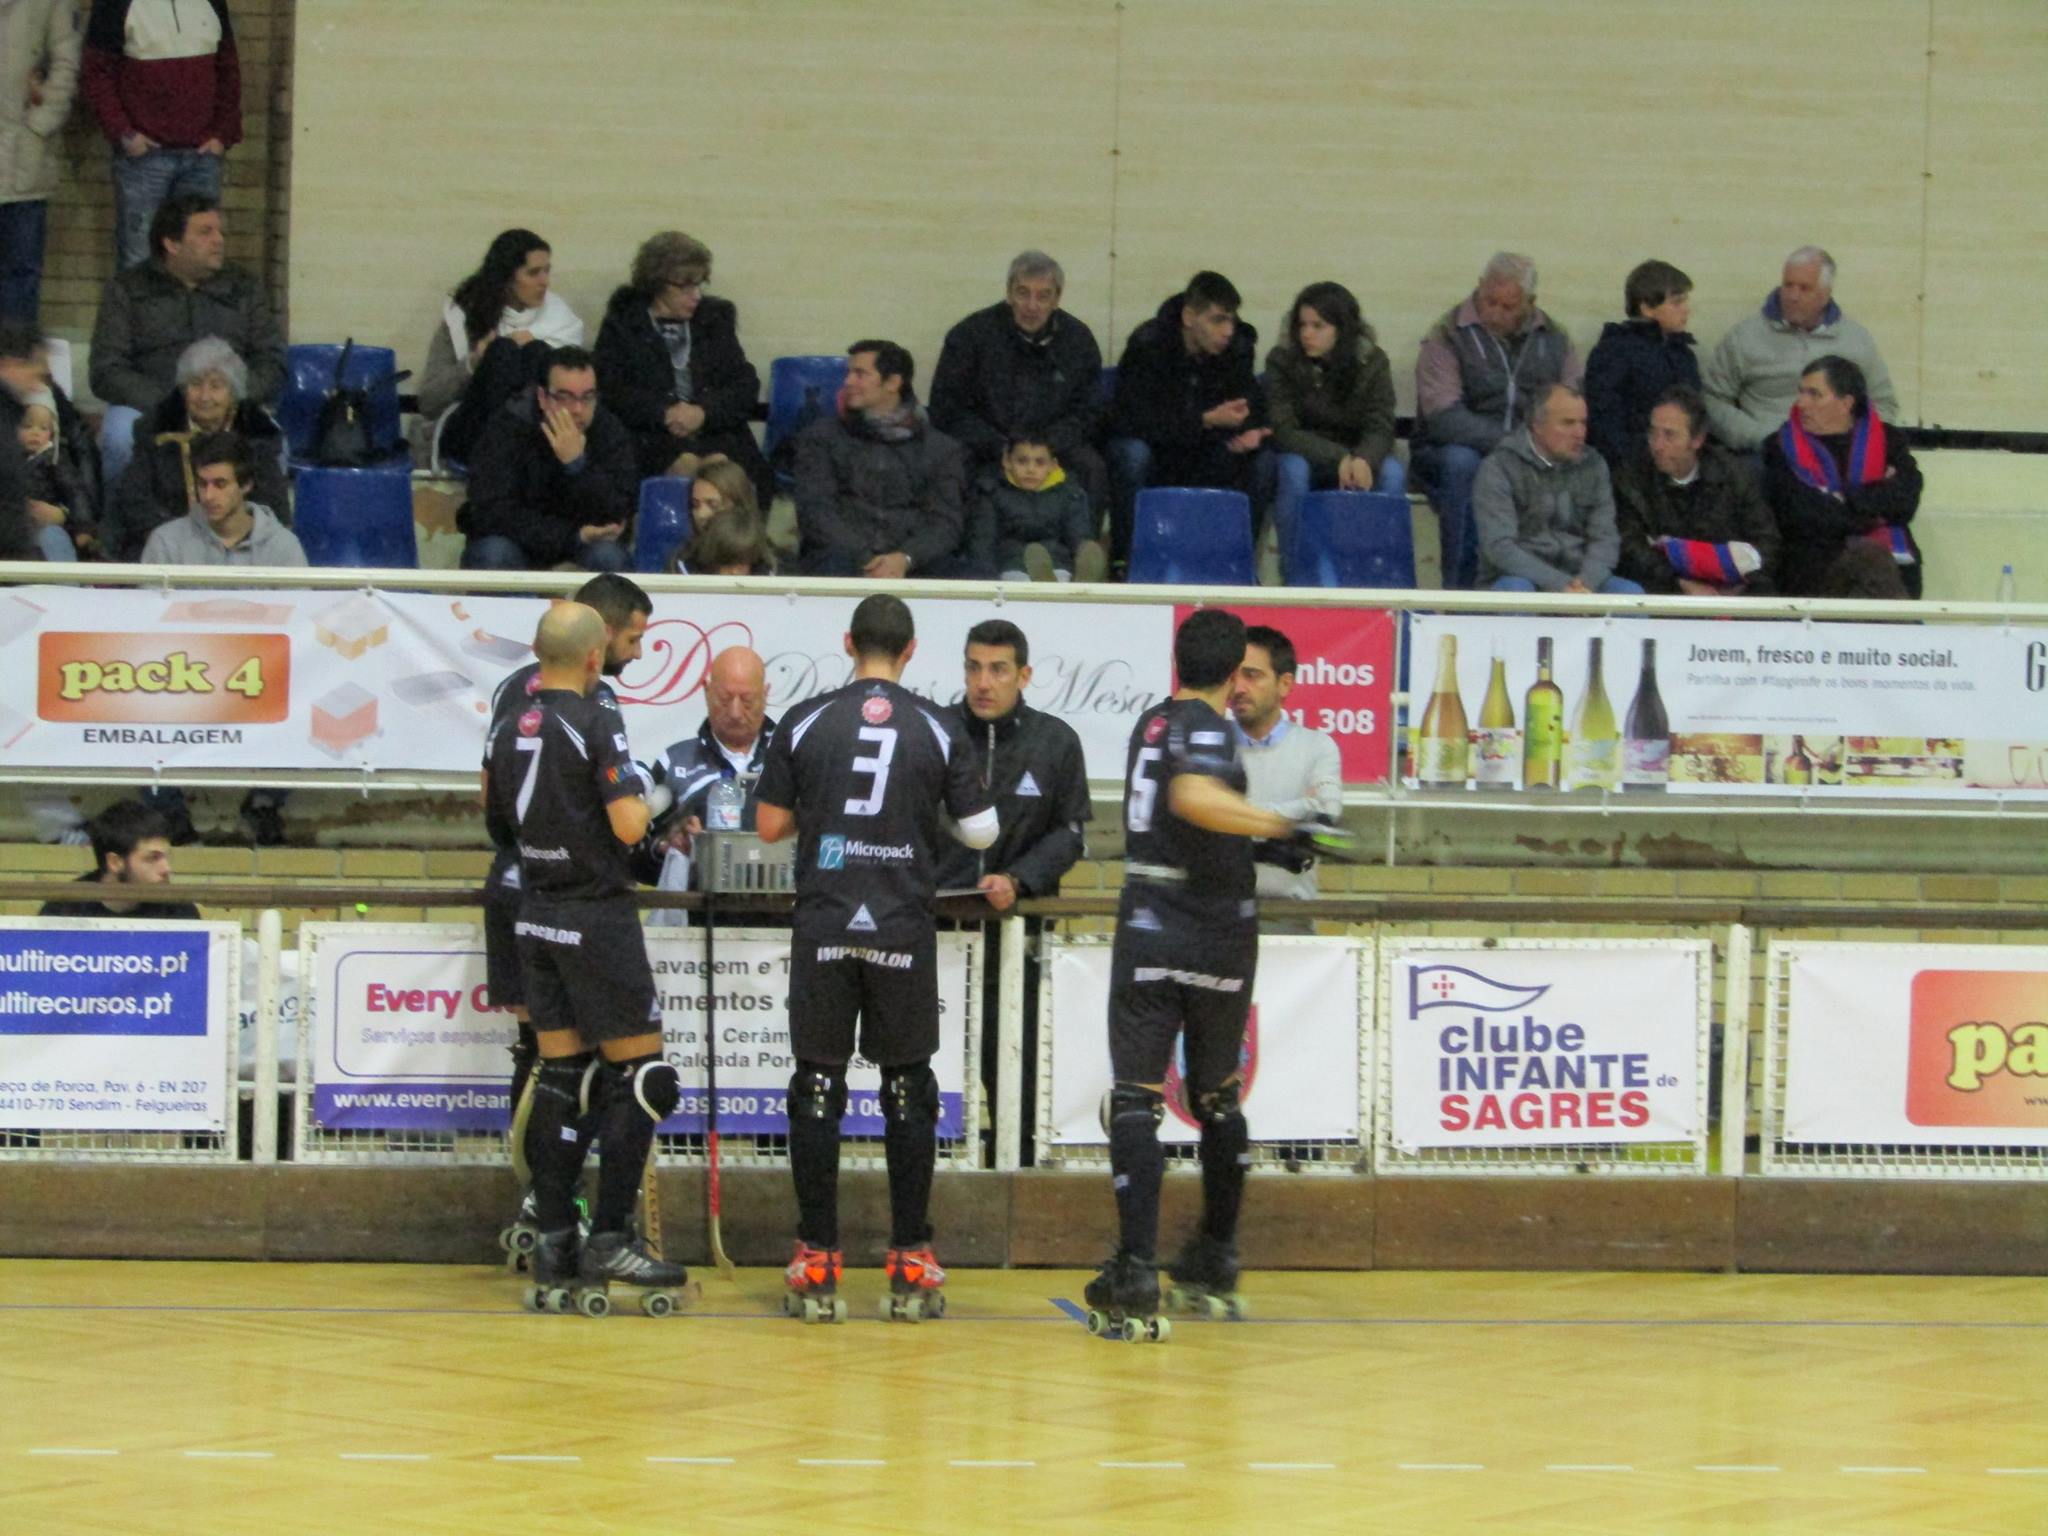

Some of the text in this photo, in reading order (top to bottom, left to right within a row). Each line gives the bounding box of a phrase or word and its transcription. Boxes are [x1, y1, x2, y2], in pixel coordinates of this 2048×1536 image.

[1688, 644, 1958, 668] Jovem, fresco e muito social.
[61, 651, 264, 700] pack 4
[1295, 657, 1375, 686] nhos
[84, 729, 243, 745] EMBALAGEM
[516, 737, 543, 825] 7
[844, 727, 897, 815] 3
[845, 840, 914, 860] Micropack
[651, 959, 749, 979] avagem
[758, 961, 771, 975] e
[366, 983, 461, 1019] Every
[660, 991, 773, 1011] imentos
[663, 1028, 697, 1043] dra
[722, 1027, 790, 1043] Cerâm
[1440, 1016, 1585, 1054] clube
[1945, 1021, 2048, 1093] pa
[1440, 1053, 1679, 1091] INFANTE de
[159, 1082, 176, 1093] EN
[182, 1081, 207, 1093] 207
[69, 1099, 120, 1111] Sendim
[136, 1100, 207, 1114] Felgueiras
[717, 1096, 758, 1115] 300
[1440, 1091, 1650, 1132] SAGRES
